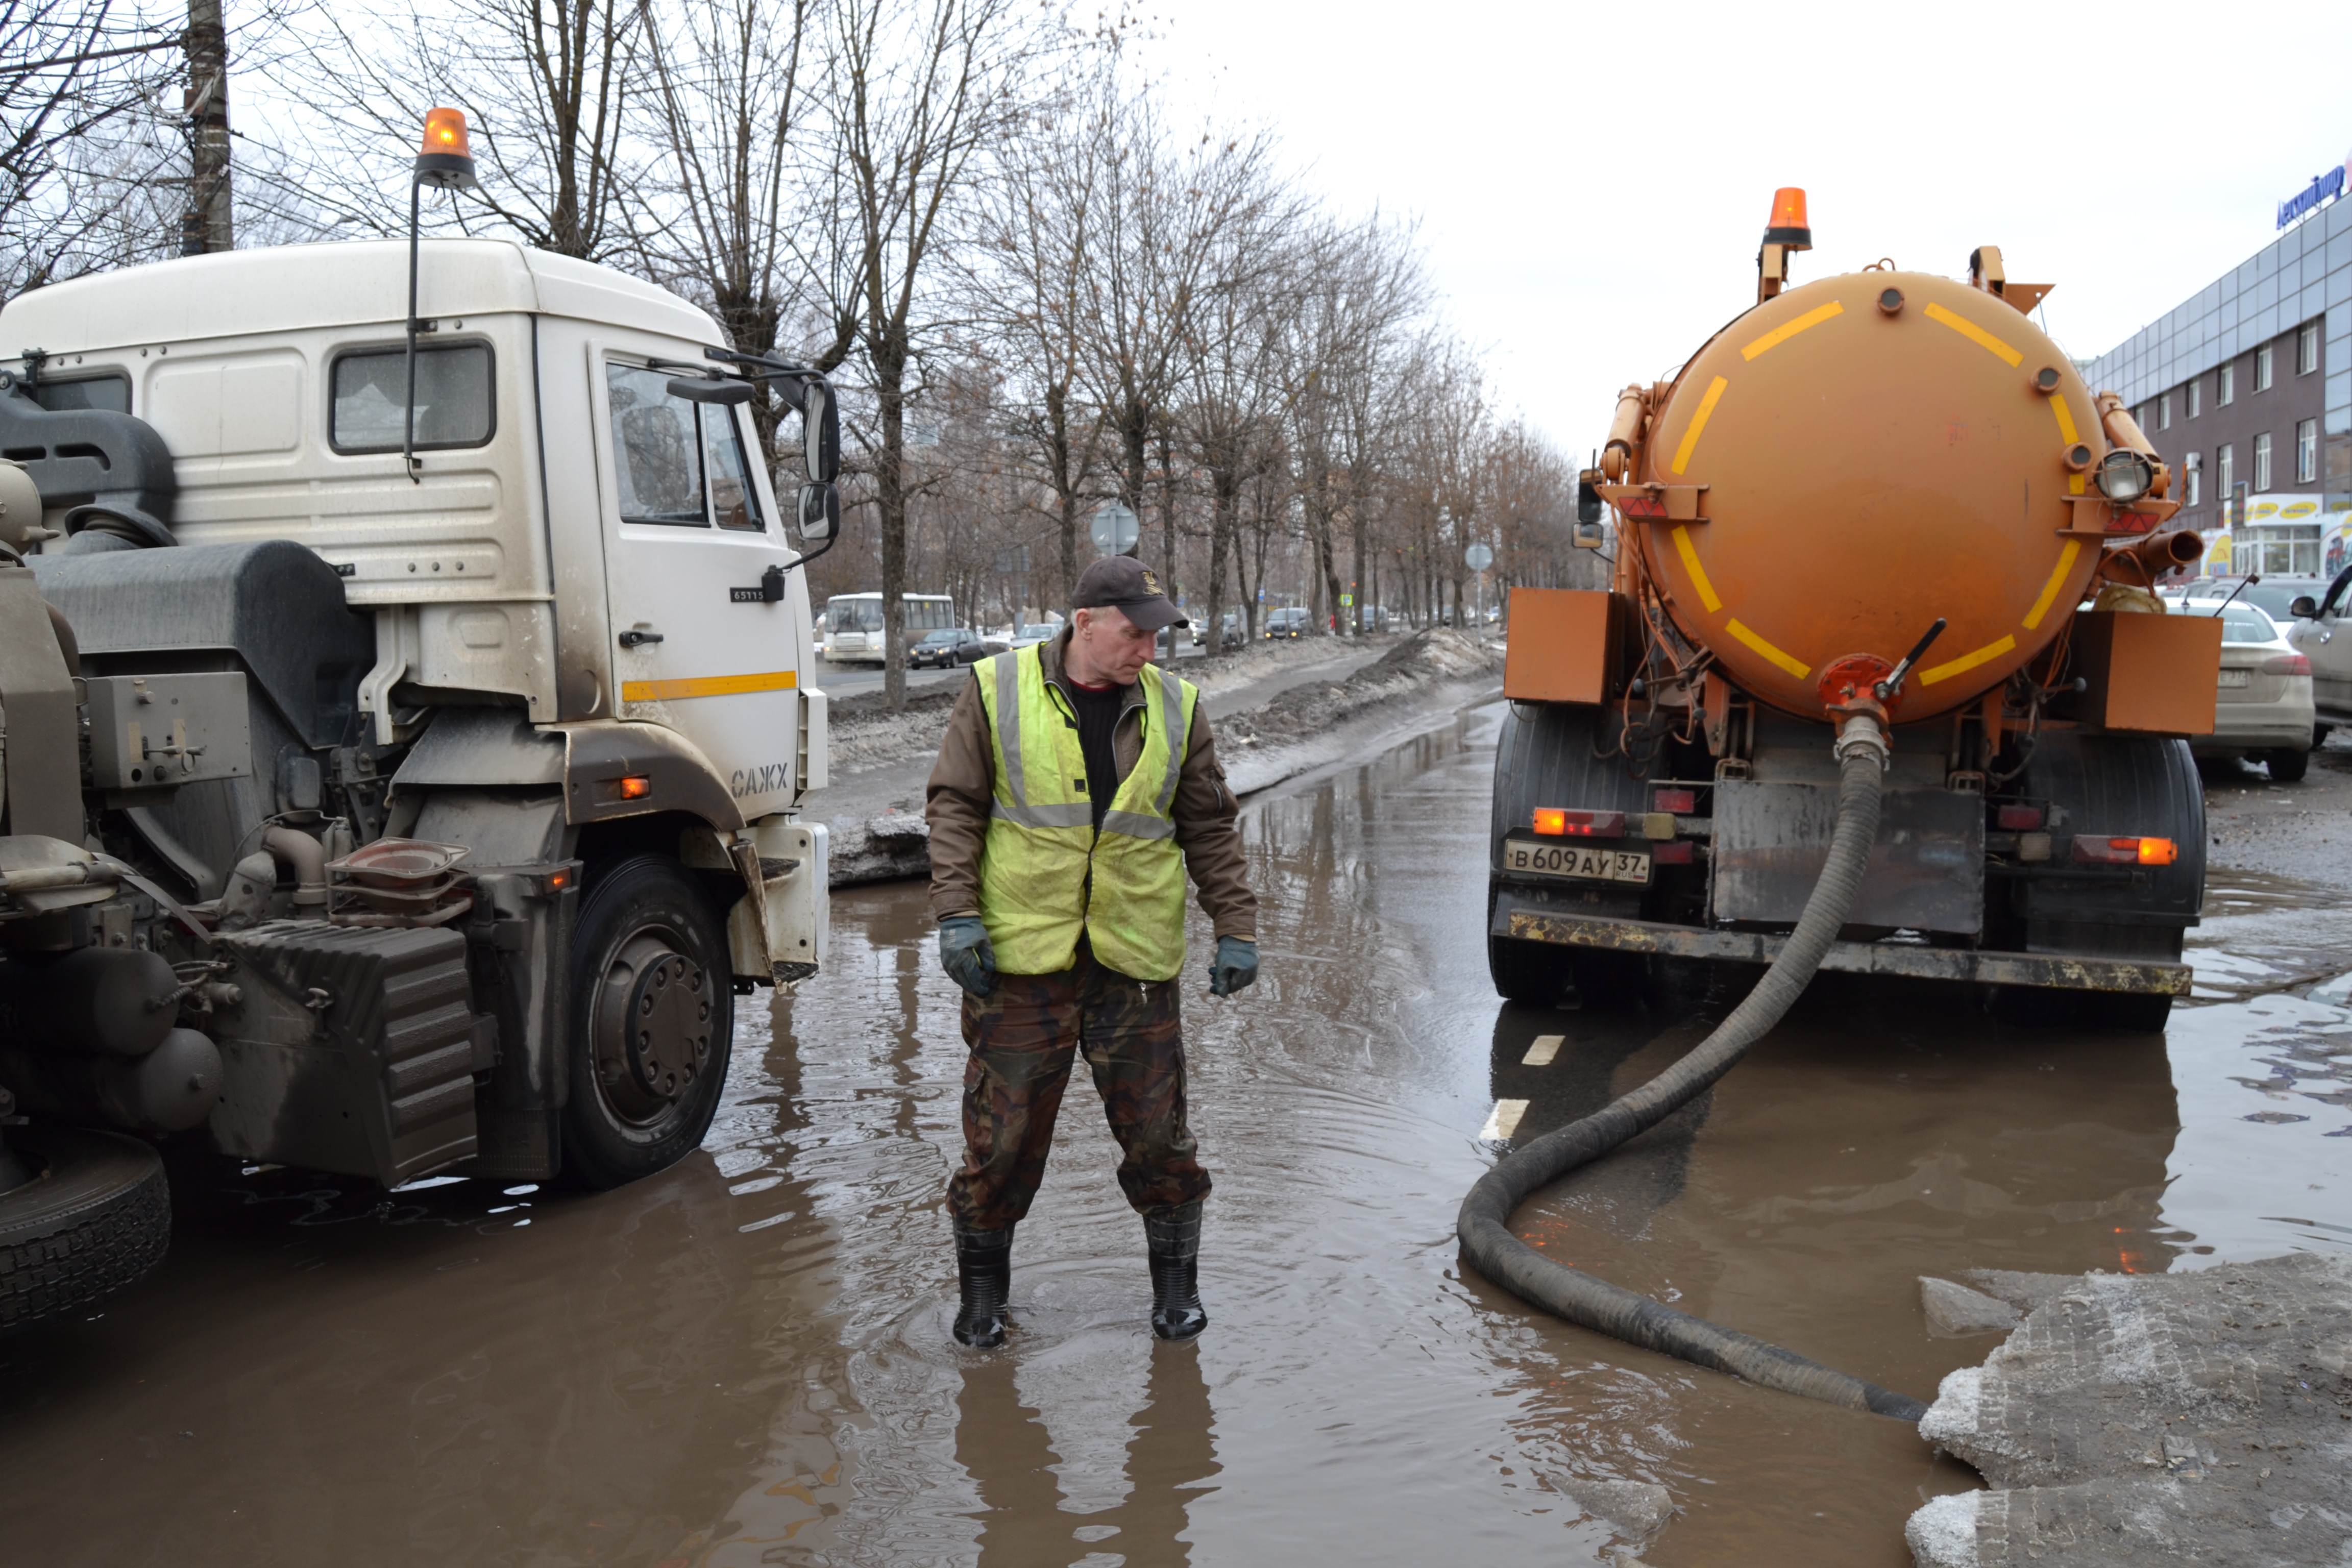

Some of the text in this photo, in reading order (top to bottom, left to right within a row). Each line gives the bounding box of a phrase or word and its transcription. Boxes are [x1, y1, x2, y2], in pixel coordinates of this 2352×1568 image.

[734, 591, 764, 599] 65115
[731, 763, 787, 798] САЖХ
[1618, 854, 1641, 872] 37
